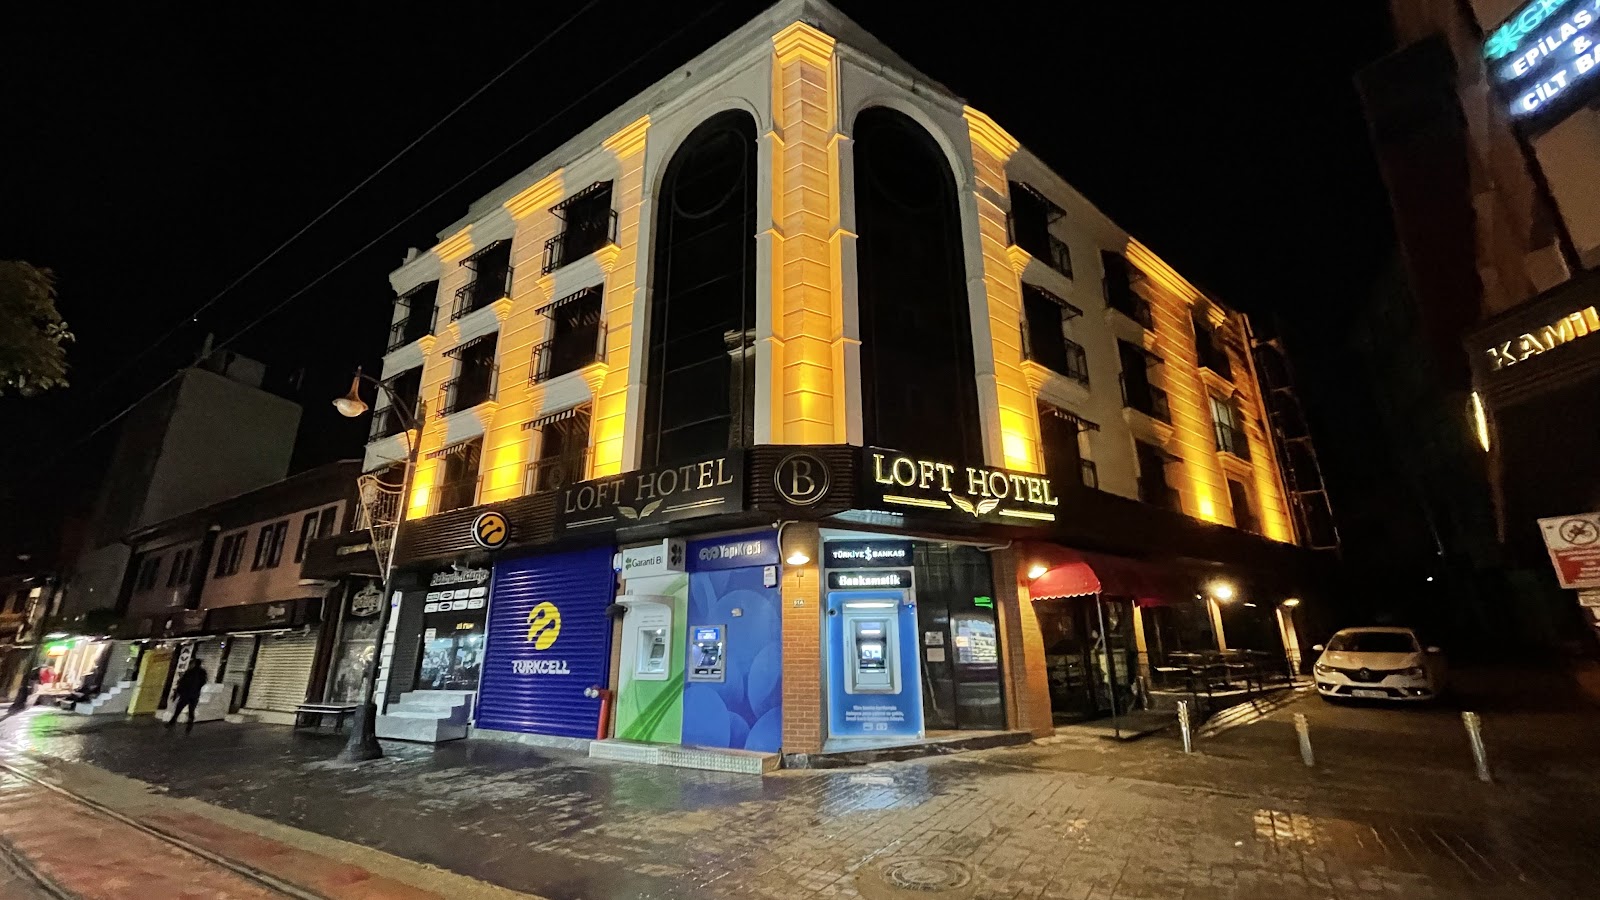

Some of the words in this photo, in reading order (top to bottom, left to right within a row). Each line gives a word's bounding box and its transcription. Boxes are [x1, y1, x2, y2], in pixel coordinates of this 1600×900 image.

[1572, 35, 1592, 54] &
[1523, 69, 1567, 110] CİLT
[564, 479, 625, 514] LOFT
[635, 458, 734, 500] HOTEL
[791, 459, 815, 496] B
[873, 453, 954, 492] LOFT
[966, 467, 1058, 506] HOTEL
[632, 556, 655, 568] Garanti
[839, 574, 901, 586] Bankamatik
[511, 660, 571, 675] TURKCELL
